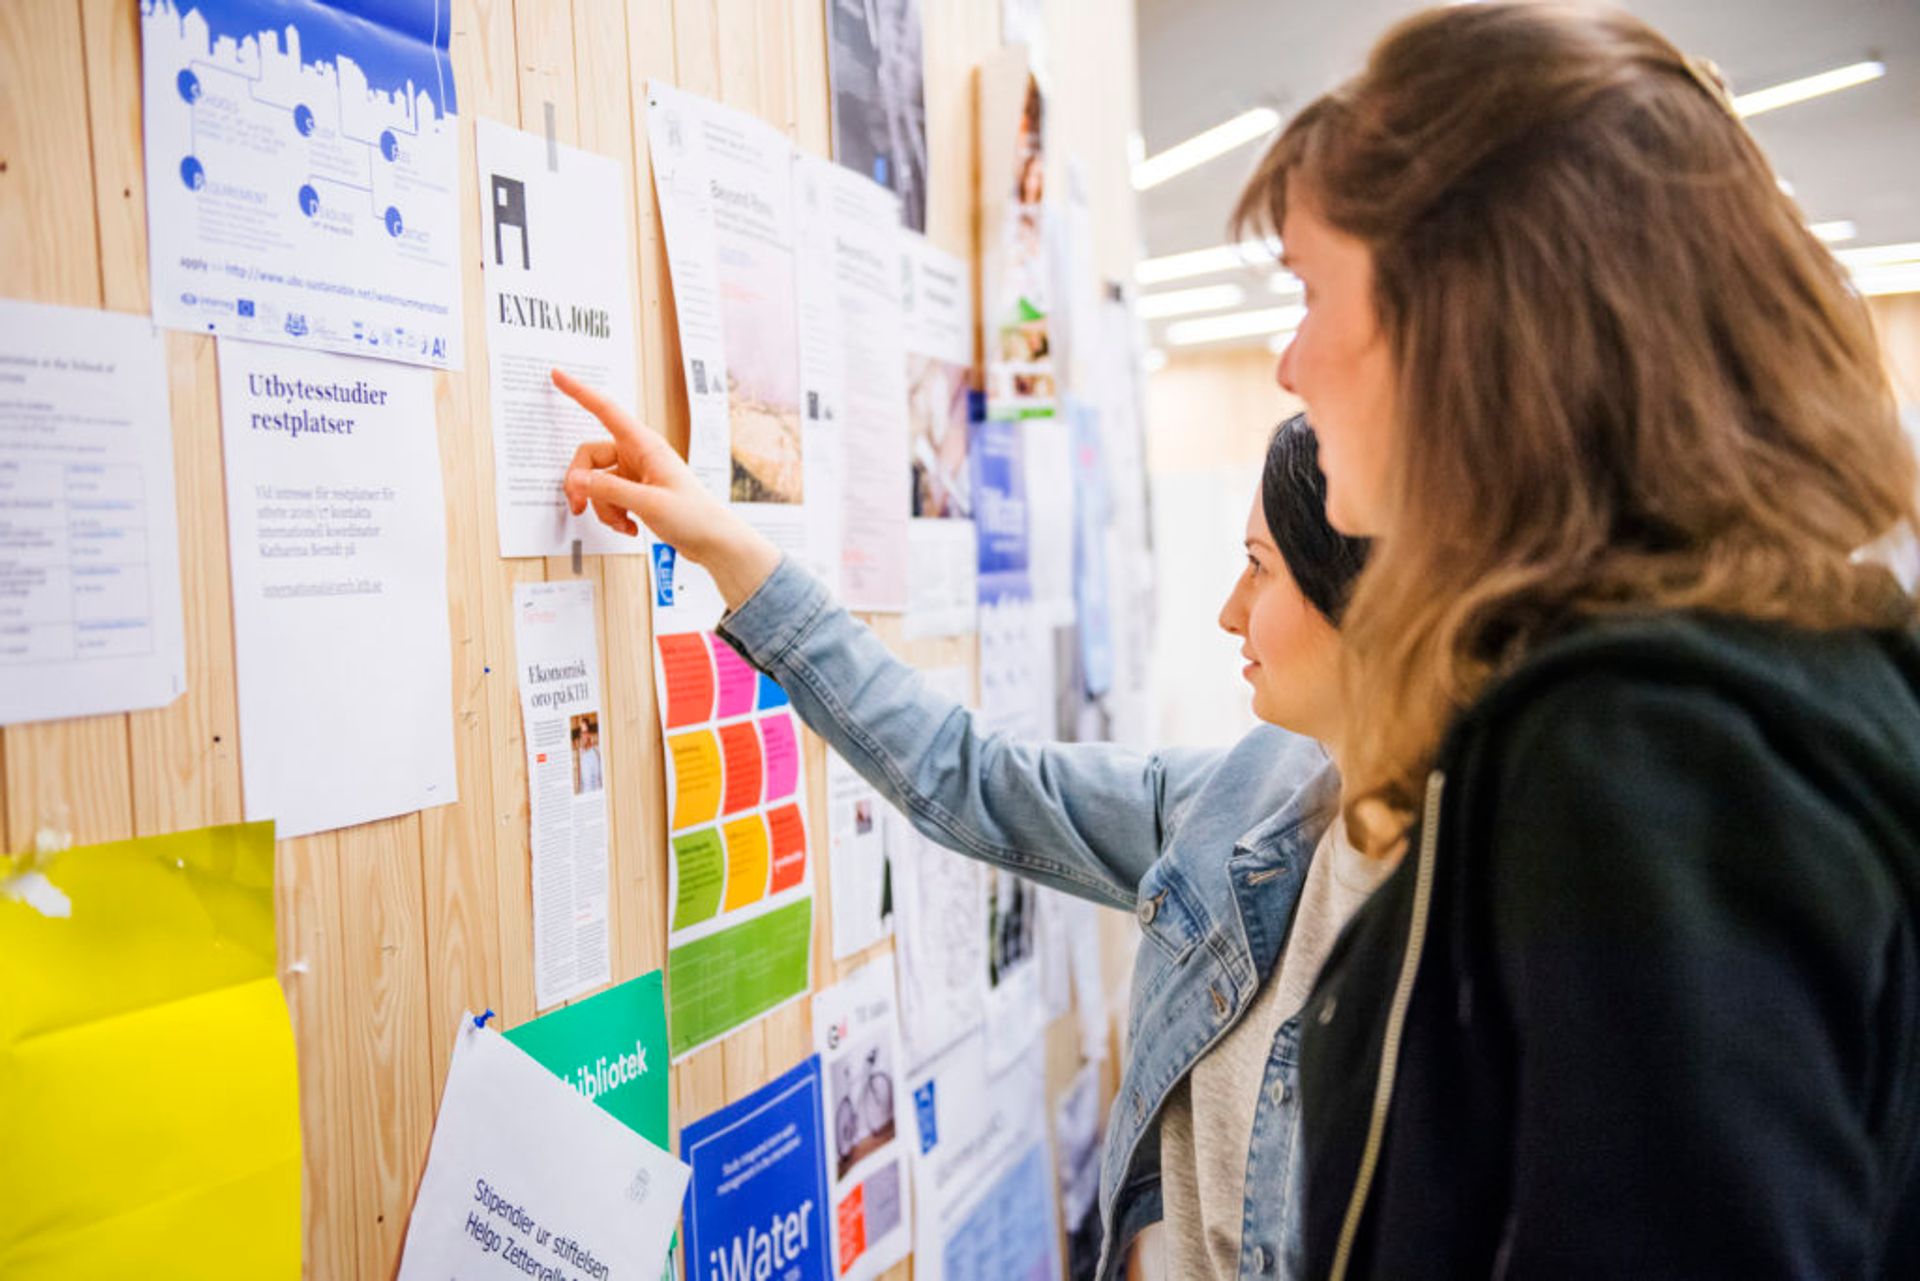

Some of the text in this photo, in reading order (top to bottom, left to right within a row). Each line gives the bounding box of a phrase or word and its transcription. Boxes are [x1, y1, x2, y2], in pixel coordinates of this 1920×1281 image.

[499, 292, 611, 339] EXTRA JOBB
[249, 373, 388, 406] Utbytesstudier
[251, 408, 355, 438] restplatser
[528, 659, 587, 685] Ekonomisk
[566, 682, 589, 703] KTH
[465, 1211, 566, 1281] Helgo Zettervall
[474, 1178, 609, 1281] Stipendier ur stiftelsen
